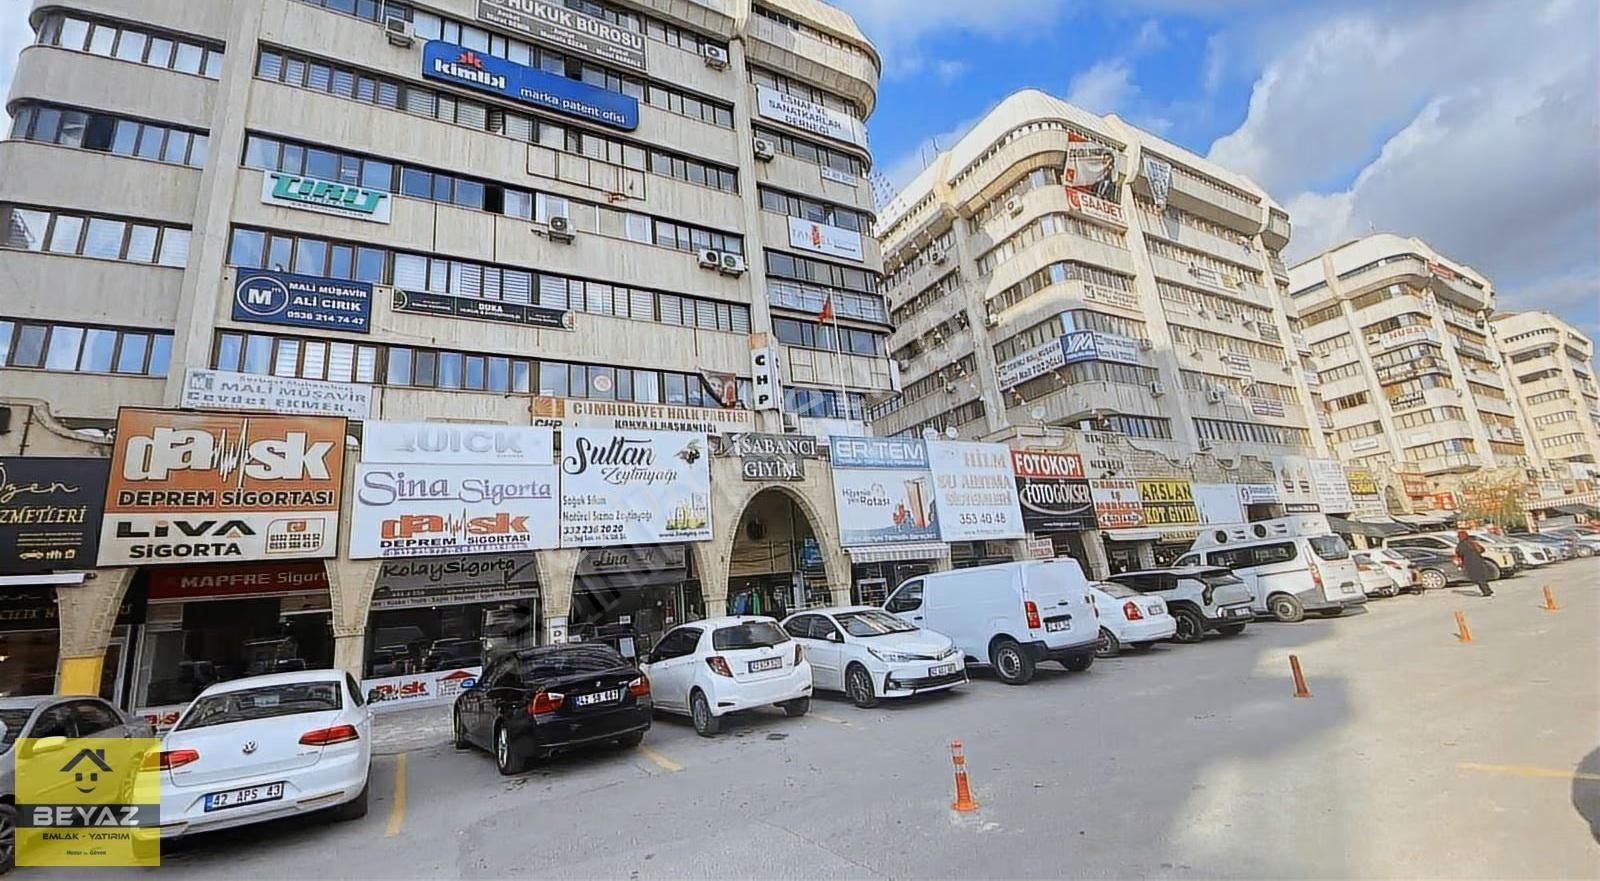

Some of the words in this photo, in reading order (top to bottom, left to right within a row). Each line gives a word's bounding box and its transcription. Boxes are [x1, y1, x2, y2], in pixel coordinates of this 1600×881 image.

[508, 0, 573, 27] HUKUK
[576, 15, 642, 49] BÜROSU
[520, 86, 559, 105] marka
[562, 99, 600, 117] patent
[602, 110, 625, 124] ofisi
[289, 282, 316, 293] MALİ
[293, 296, 317, 307] ALİ
[315, 313, 335, 322] 214
[335, 315, 350, 324] 74
[351, 316, 365, 325] 47
[667, 407, 700, 420] HALK
[393, 430, 523, 454] UICK
[742, 438, 817, 456] SABANCI
[562, 435, 657, 475] Sultan
[358, 471, 449, 506] Sina
[459, 479, 551, 505] Sigorta
[1142, 482, 1192, 501] ARSLAN
[119, 491, 214, 506] DEPREM
[960, 512, 978, 524] 353
[981, 513, 992, 524] 40
[1146, 506, 1167, 524] KOT
[380, 537, 457, 549] DEPREM
[181, 573, 270, 588] MAPFRE
[276, 571, 328, 587] Sigort
[213, 794, 228, 806] 42
[237, 790, 259, 803] APS
[266, 784, 281, 797] 43
